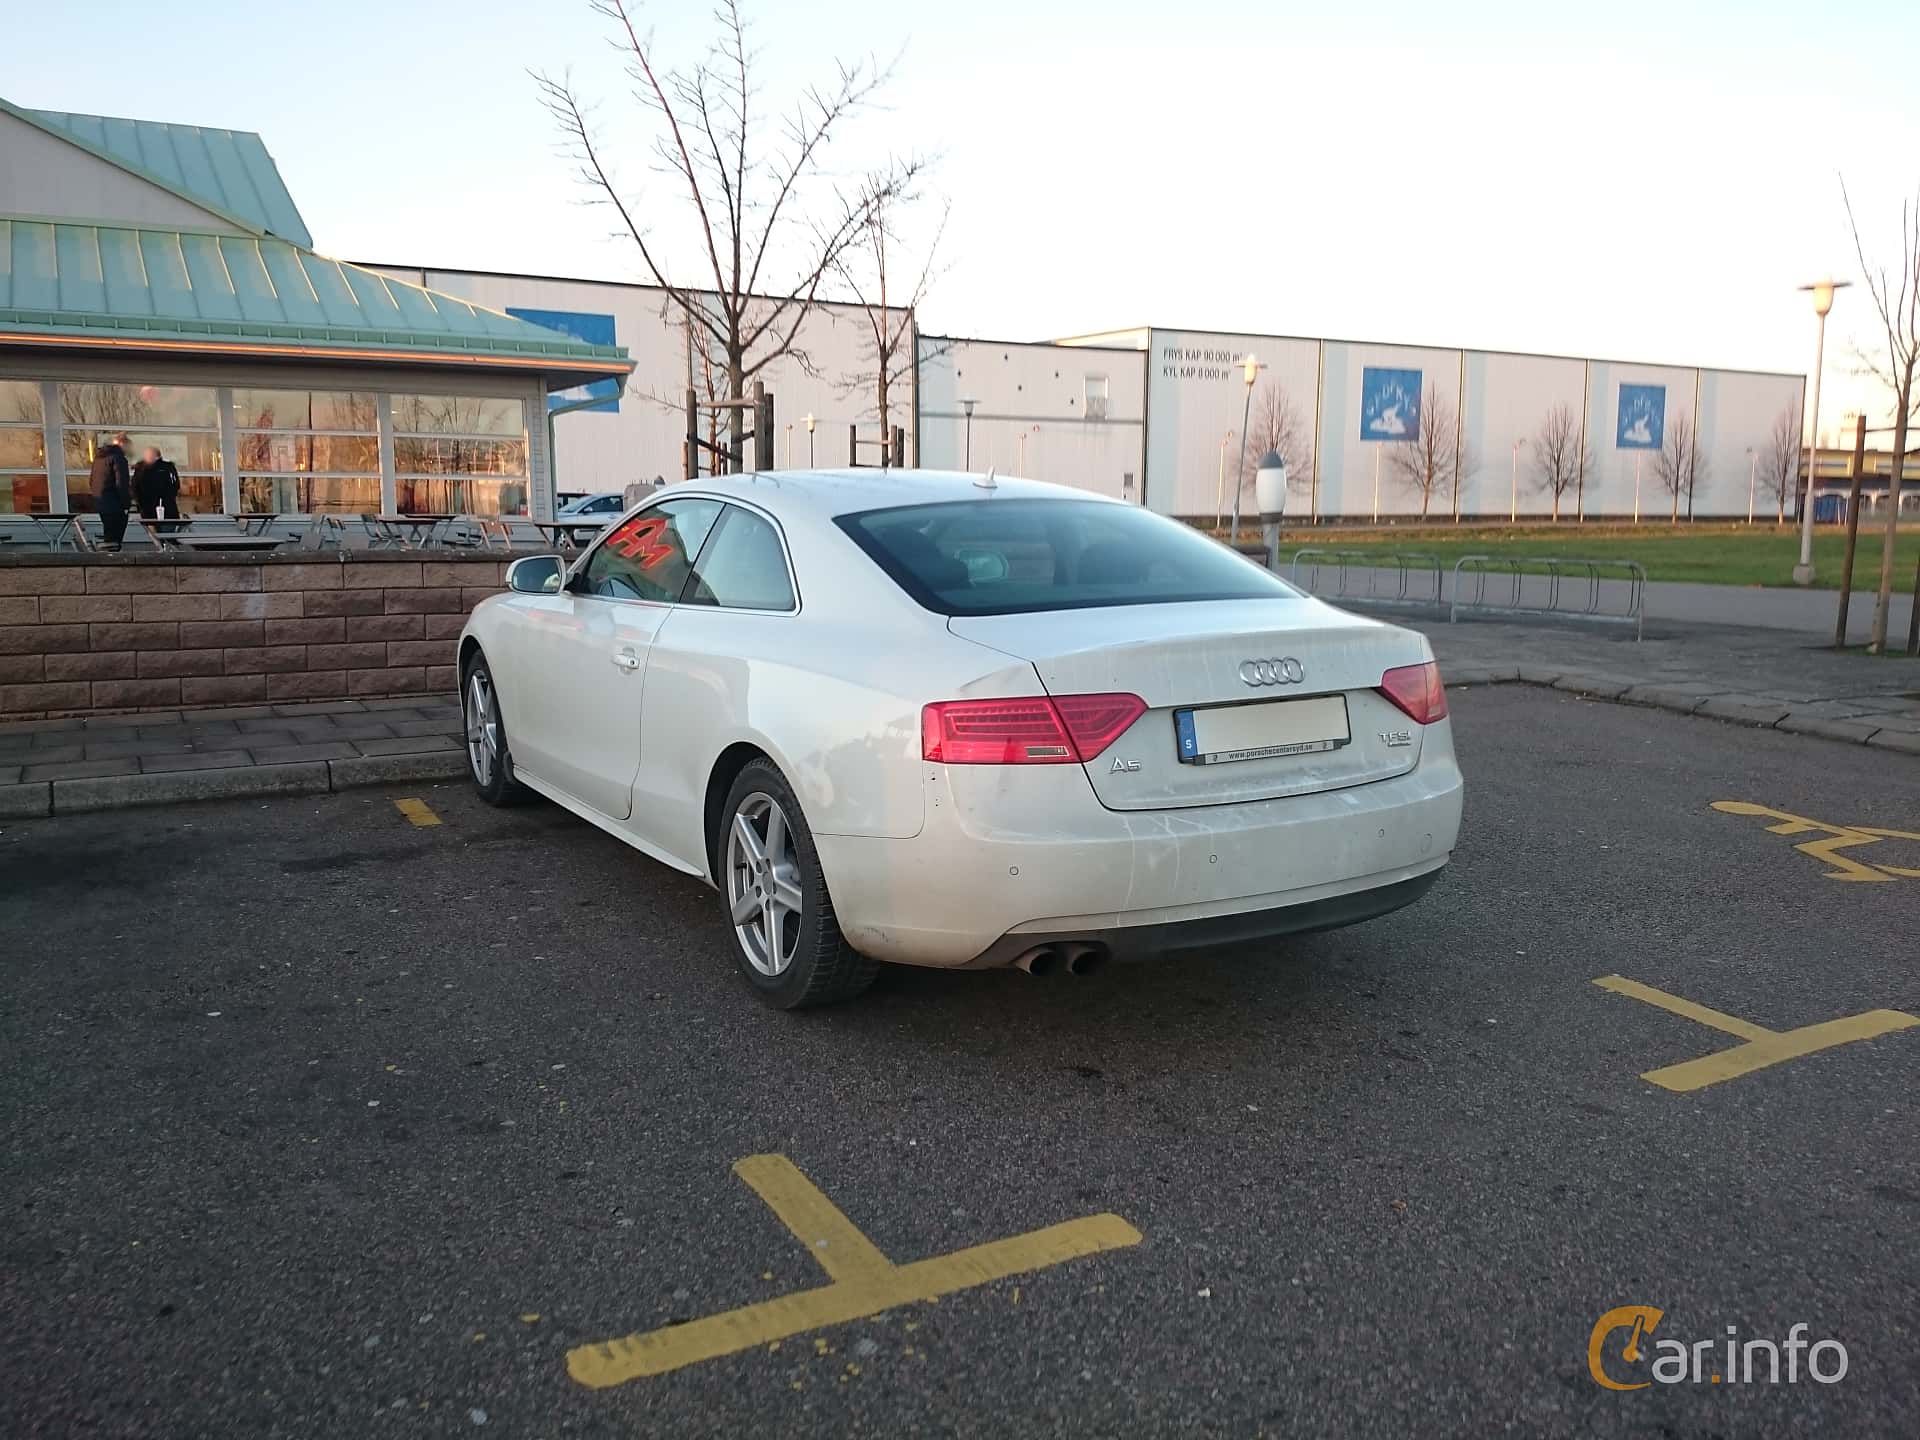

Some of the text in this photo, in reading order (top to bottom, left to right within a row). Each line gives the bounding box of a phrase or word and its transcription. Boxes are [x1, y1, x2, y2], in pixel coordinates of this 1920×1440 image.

[1185, 349, 1201, 361] KAP
[1215, 350, 1231, 363] 000
[1163, 366, 1177, 377] KYL
[1180, 367, 1196, 378] KAP
[1204, 368, 1220, 381] 000
[1185, 739, 1193, 749] S
[1110, 757, 1141, 772] A5
